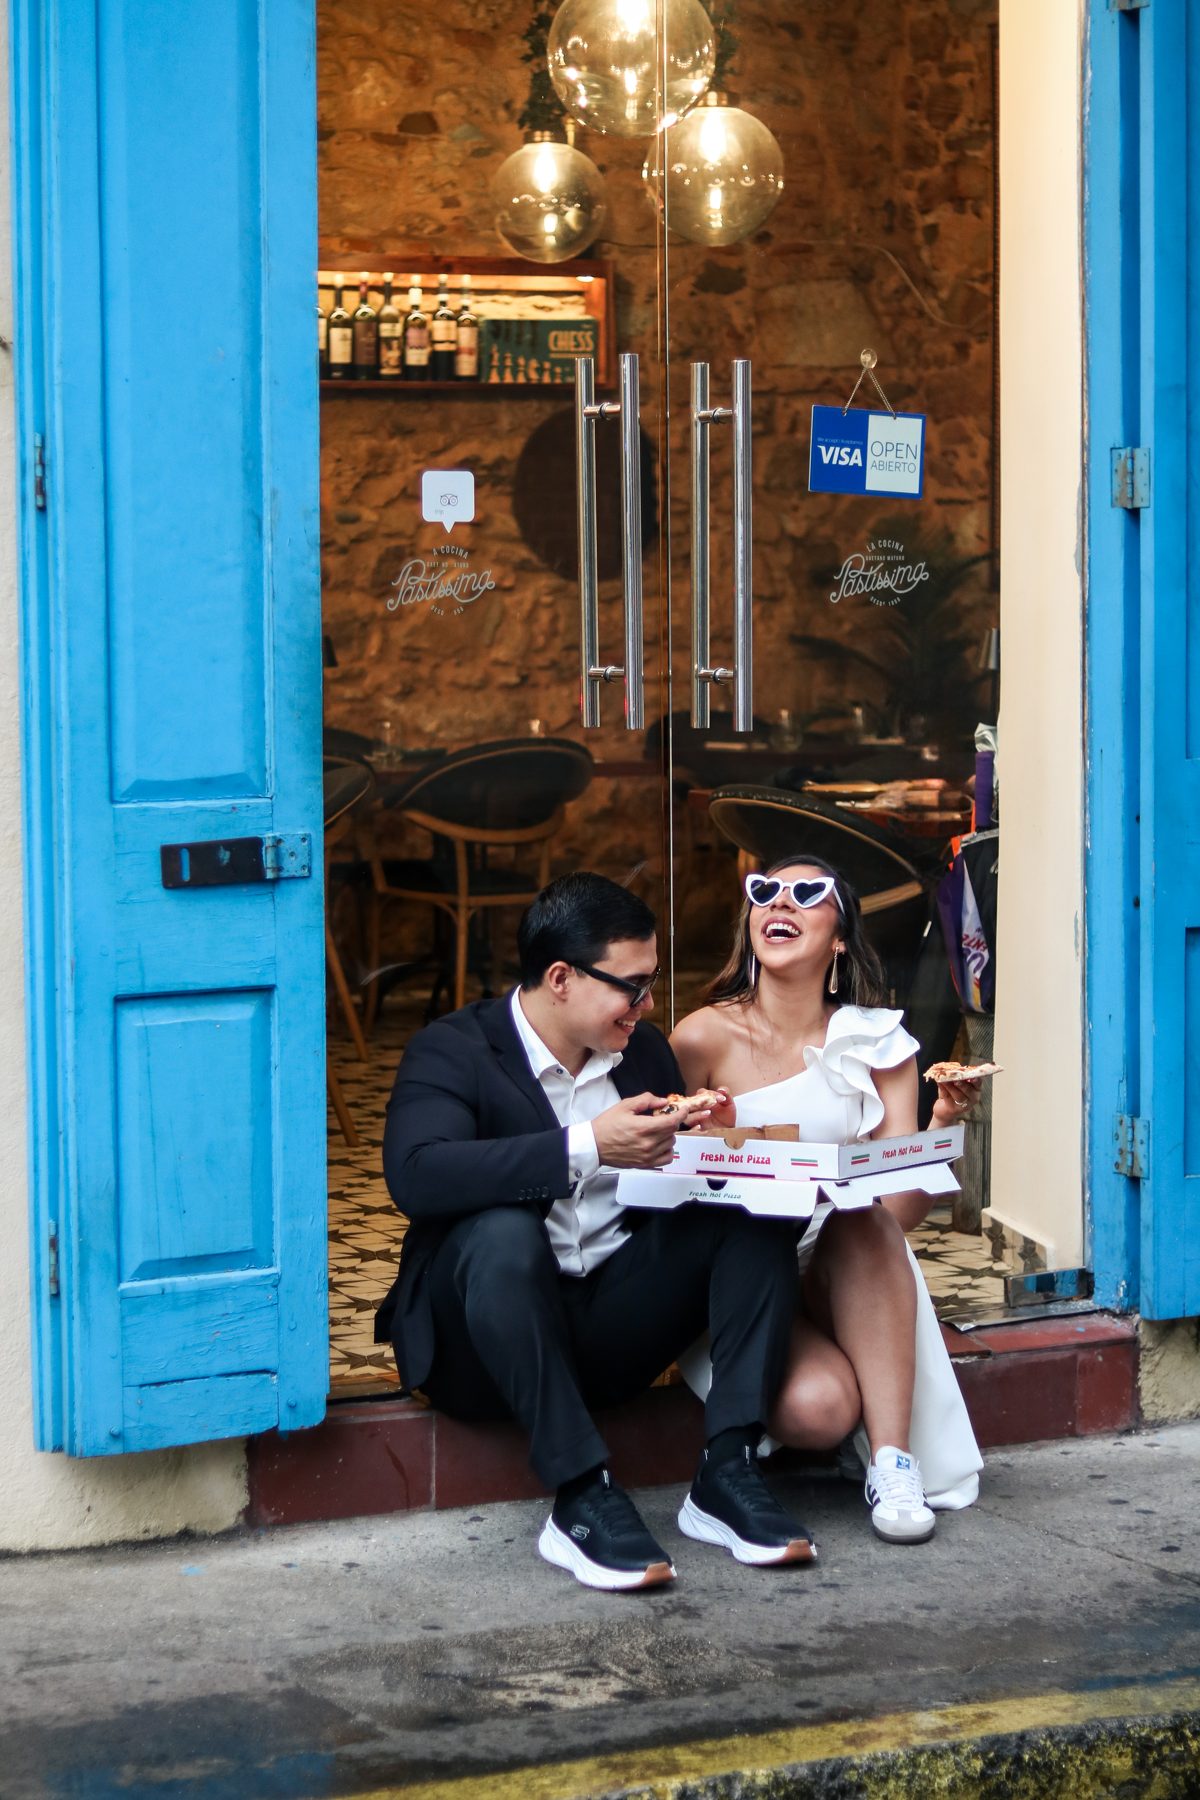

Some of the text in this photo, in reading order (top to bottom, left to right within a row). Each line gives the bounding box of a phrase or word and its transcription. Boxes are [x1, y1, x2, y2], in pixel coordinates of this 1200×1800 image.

[547, 330, 594, 352] CHESS
[817, 445, 863, 467] VISA
[870, 440, 918, 460] OPEN
[870, 460, 917, 474] ABIERTO
[440, 545, 469, 560] COCINA
[866, 539, 904, 553] LA COCINA
[387, 559, 496, 612] Pastissima
[829, 553, 930, 604] Pastissima
[700, 1152, 771, 1166] Fresh Hot Pizza
[881, 1145, 923, 1159] Fresh Hot Pizza
[688, 1190, 708, 1198] Fresh
[709, 1191, 721, 1199] Hot
